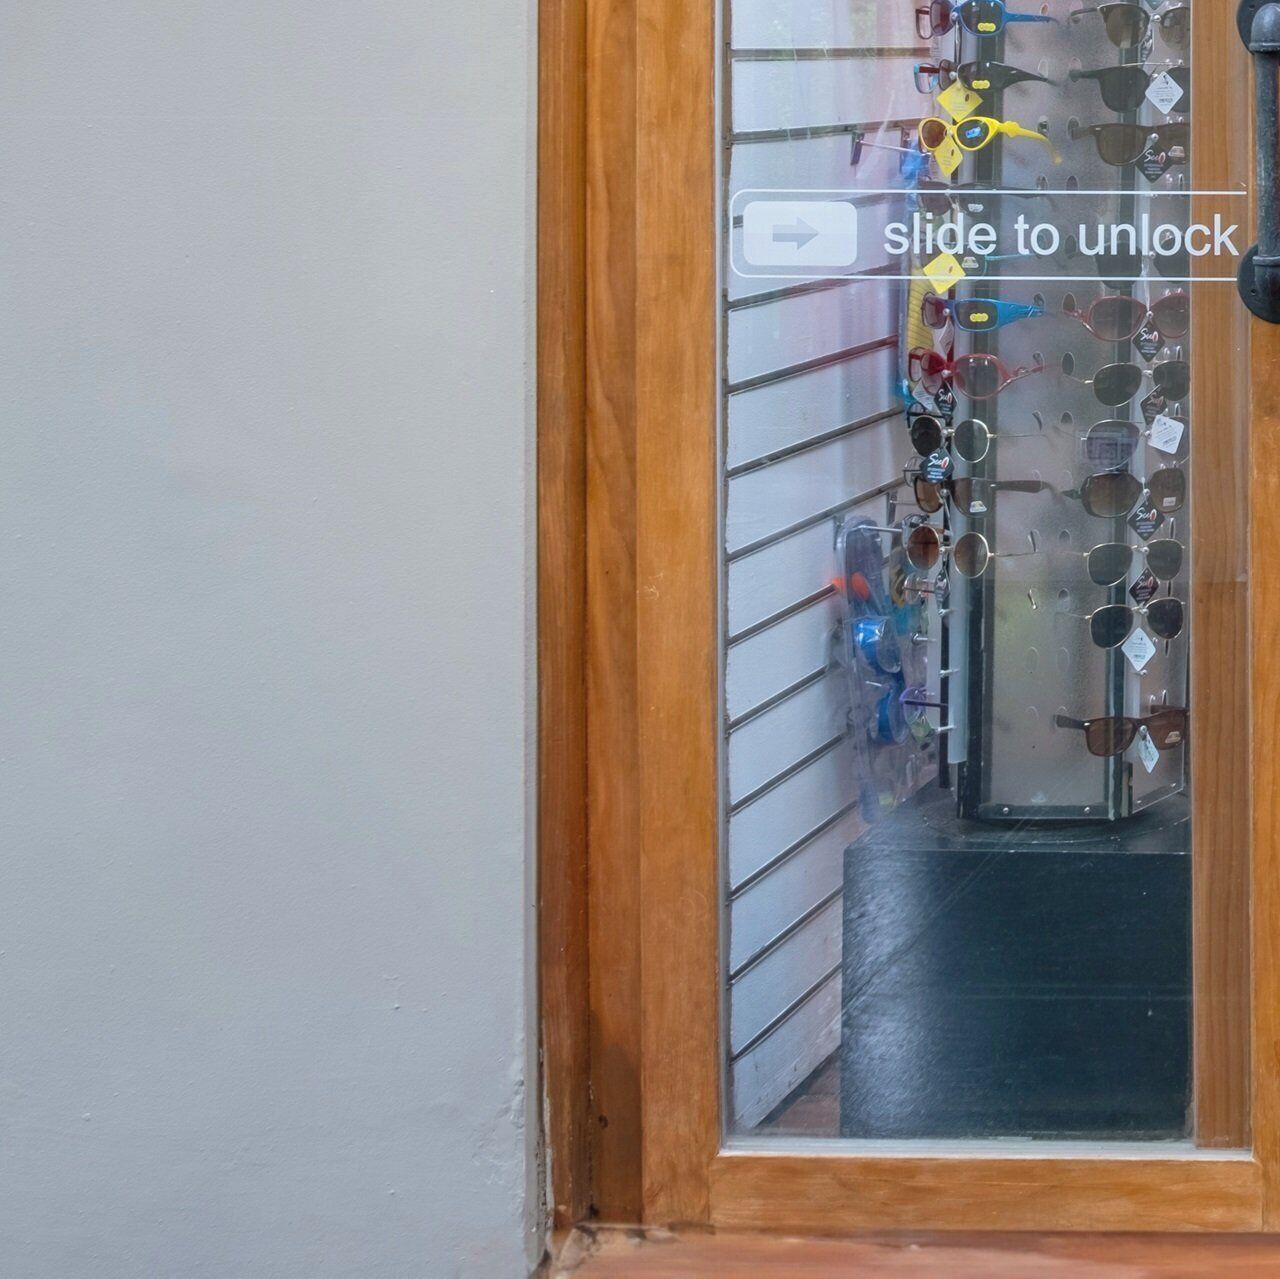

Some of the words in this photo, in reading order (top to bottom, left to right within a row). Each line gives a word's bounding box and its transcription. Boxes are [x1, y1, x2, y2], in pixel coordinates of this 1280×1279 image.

[883, 213, 997, 256] slide
[1016, 214, 1060, 256] to
[1079, 214, 1239, 256] unlock
